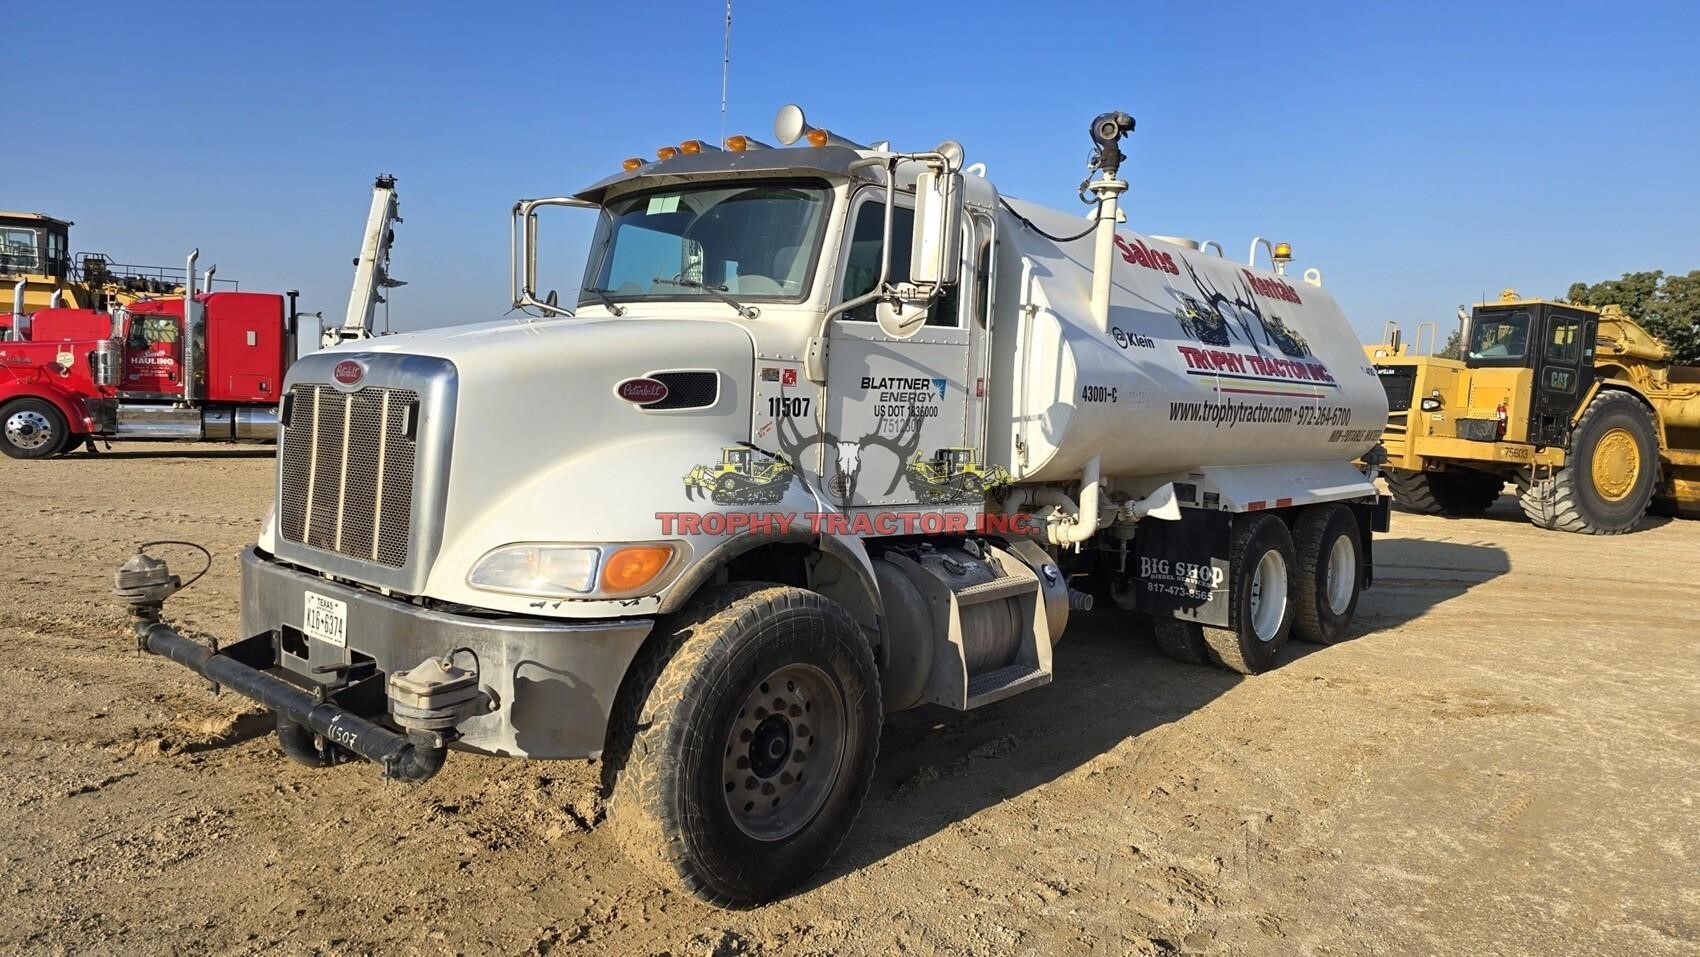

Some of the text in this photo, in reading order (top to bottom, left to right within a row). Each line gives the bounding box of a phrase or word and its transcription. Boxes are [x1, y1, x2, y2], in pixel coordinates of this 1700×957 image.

[1114, 233, 1302, 305] Sales Rentals
[1126, 332, 1155, 349] Klein
[130, 357, 175, 366] HAULING
[1177, 345, 1248, 374] TROPHY
[1245, 354, 1312, 380] TRACTOR
[1306, 362, 1336, 383] INC.
[860, 376, 931, 390] BLATTNER
[1550, 371, 1570, 389] CAT
[879, 391, 936, 403] ENERGY
[1081, 384, 1118, 404] 43001-C
[768, 396, 811, 418] 11507
[873, 404, 886, 418] US
[887, 405, 905, 418] DOT
[1169, 398, 1293, 429] www.trophytractor.com
[1296, 405, 1352, 427] 972-264-6700
[1504, 447, 1529, 459] 75603
[1140, 556, 1224, 589] BIG SHOP
[1147, 582, 1214, 602] 817-473-8565
[317, 597, 334, 610] TEXAS
